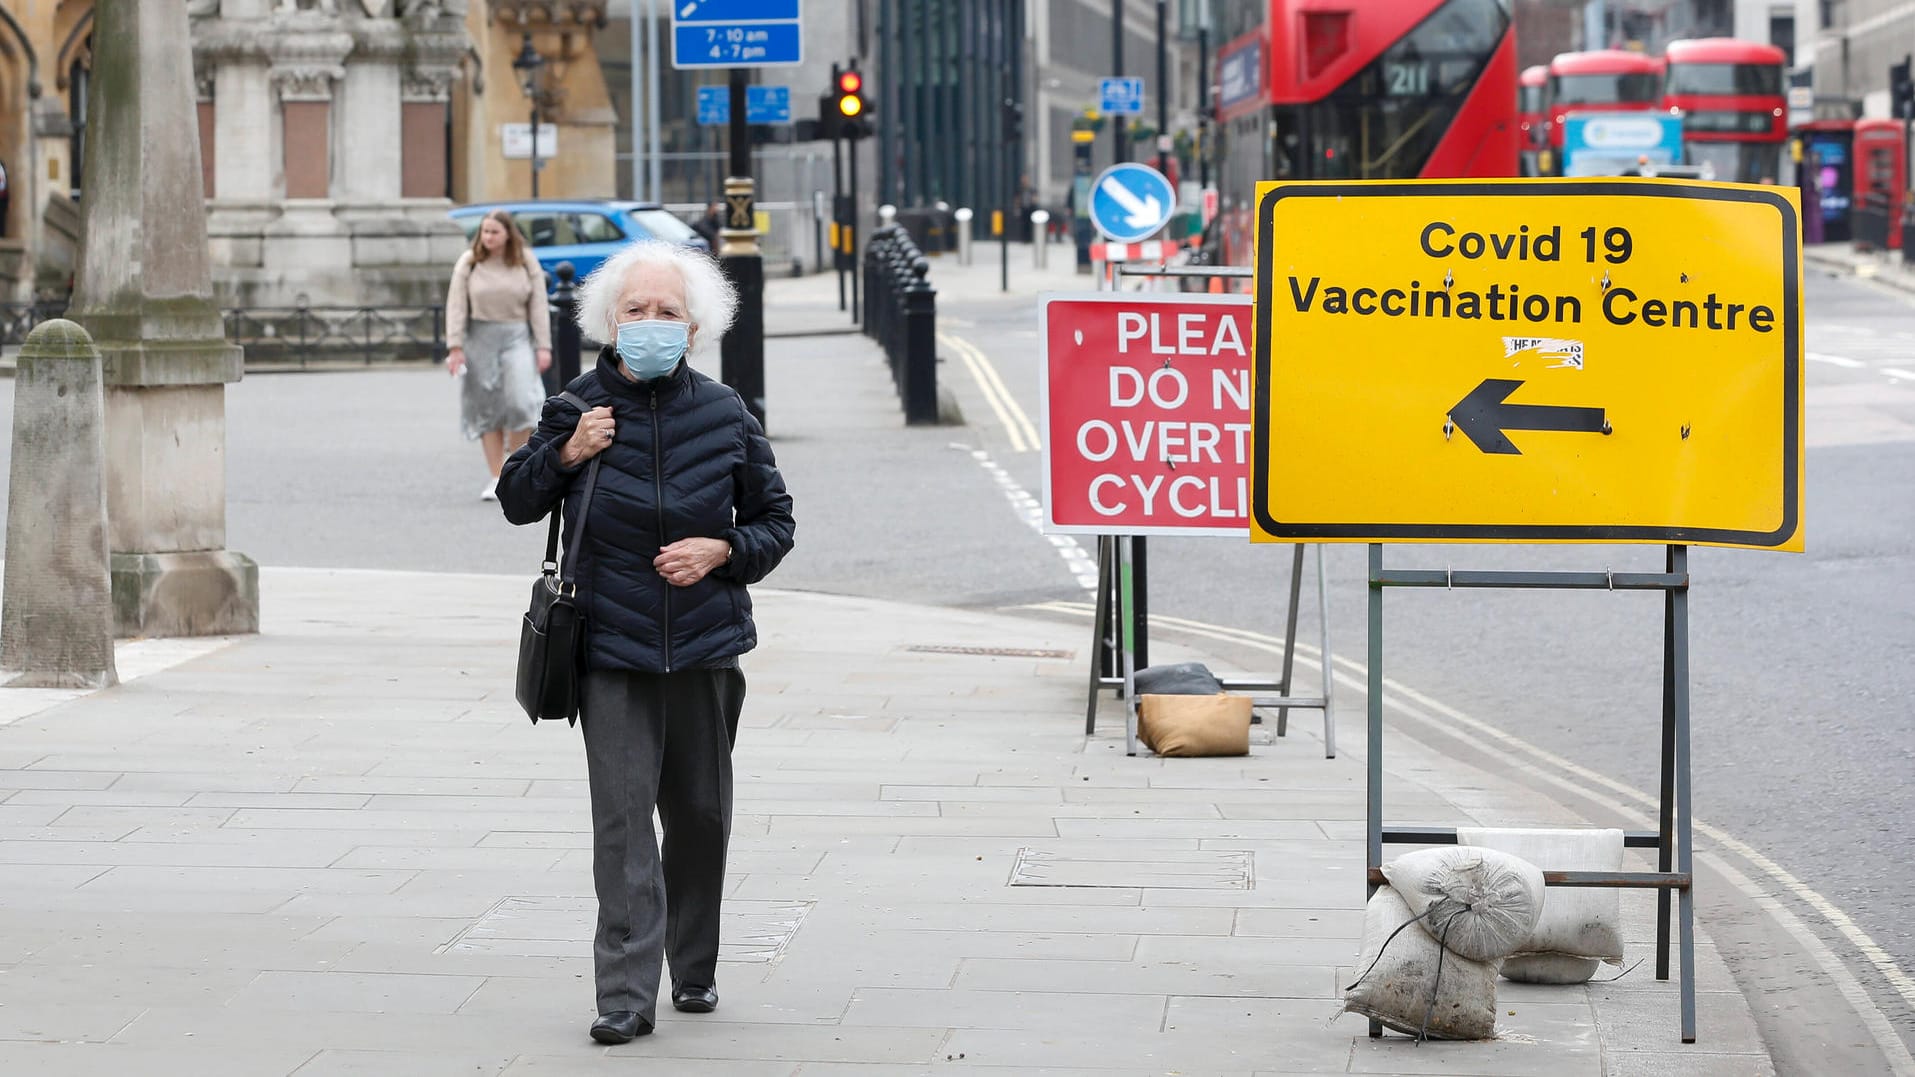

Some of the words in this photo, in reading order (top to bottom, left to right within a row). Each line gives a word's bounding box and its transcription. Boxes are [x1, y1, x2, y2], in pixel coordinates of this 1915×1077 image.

[742, 46, 766, 60] pm
[746, 30, 769, 42] am
[1390, 63, 1428, 94] 211
[1421, 222, 1562, 262] Covid
[1580, 226, 1633, 265] 19
[1288, 276, 1581, 323] Vaccination
[1602, 286, 1775, 333] Centre
[1117, 312, 1253, 357] PLEA
[1109, 367, 1189, 410] DO
[1212, 368, 1253, 411] N
[1076, 420, 1253, 464] OVERT
[1088, 473, 1252, 518] CYCLI
